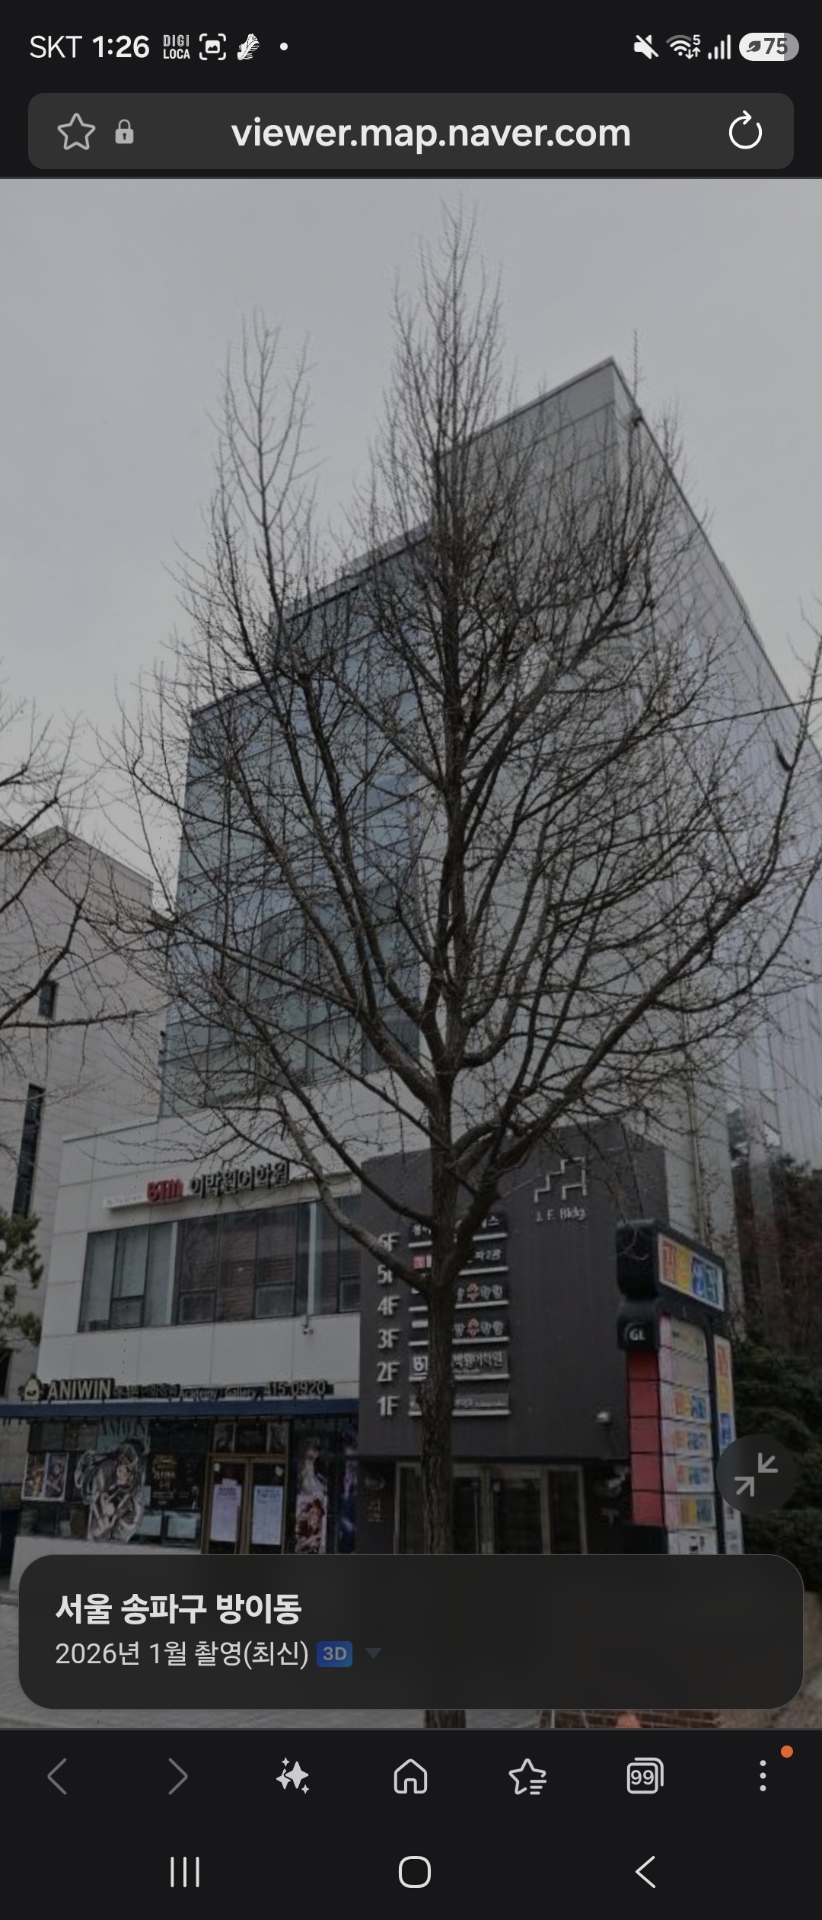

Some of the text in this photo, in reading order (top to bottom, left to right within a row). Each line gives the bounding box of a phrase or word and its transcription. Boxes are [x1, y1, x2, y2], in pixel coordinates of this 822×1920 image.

[377, 1295, 400, 1316] 4F
[377, 1328, 401, 1349] 3F
[376, 1361, 400, 1382] 2F
[47, 1378, 114, 1400] ANIWIN
[378, 1395, 400, 1417] 1F
